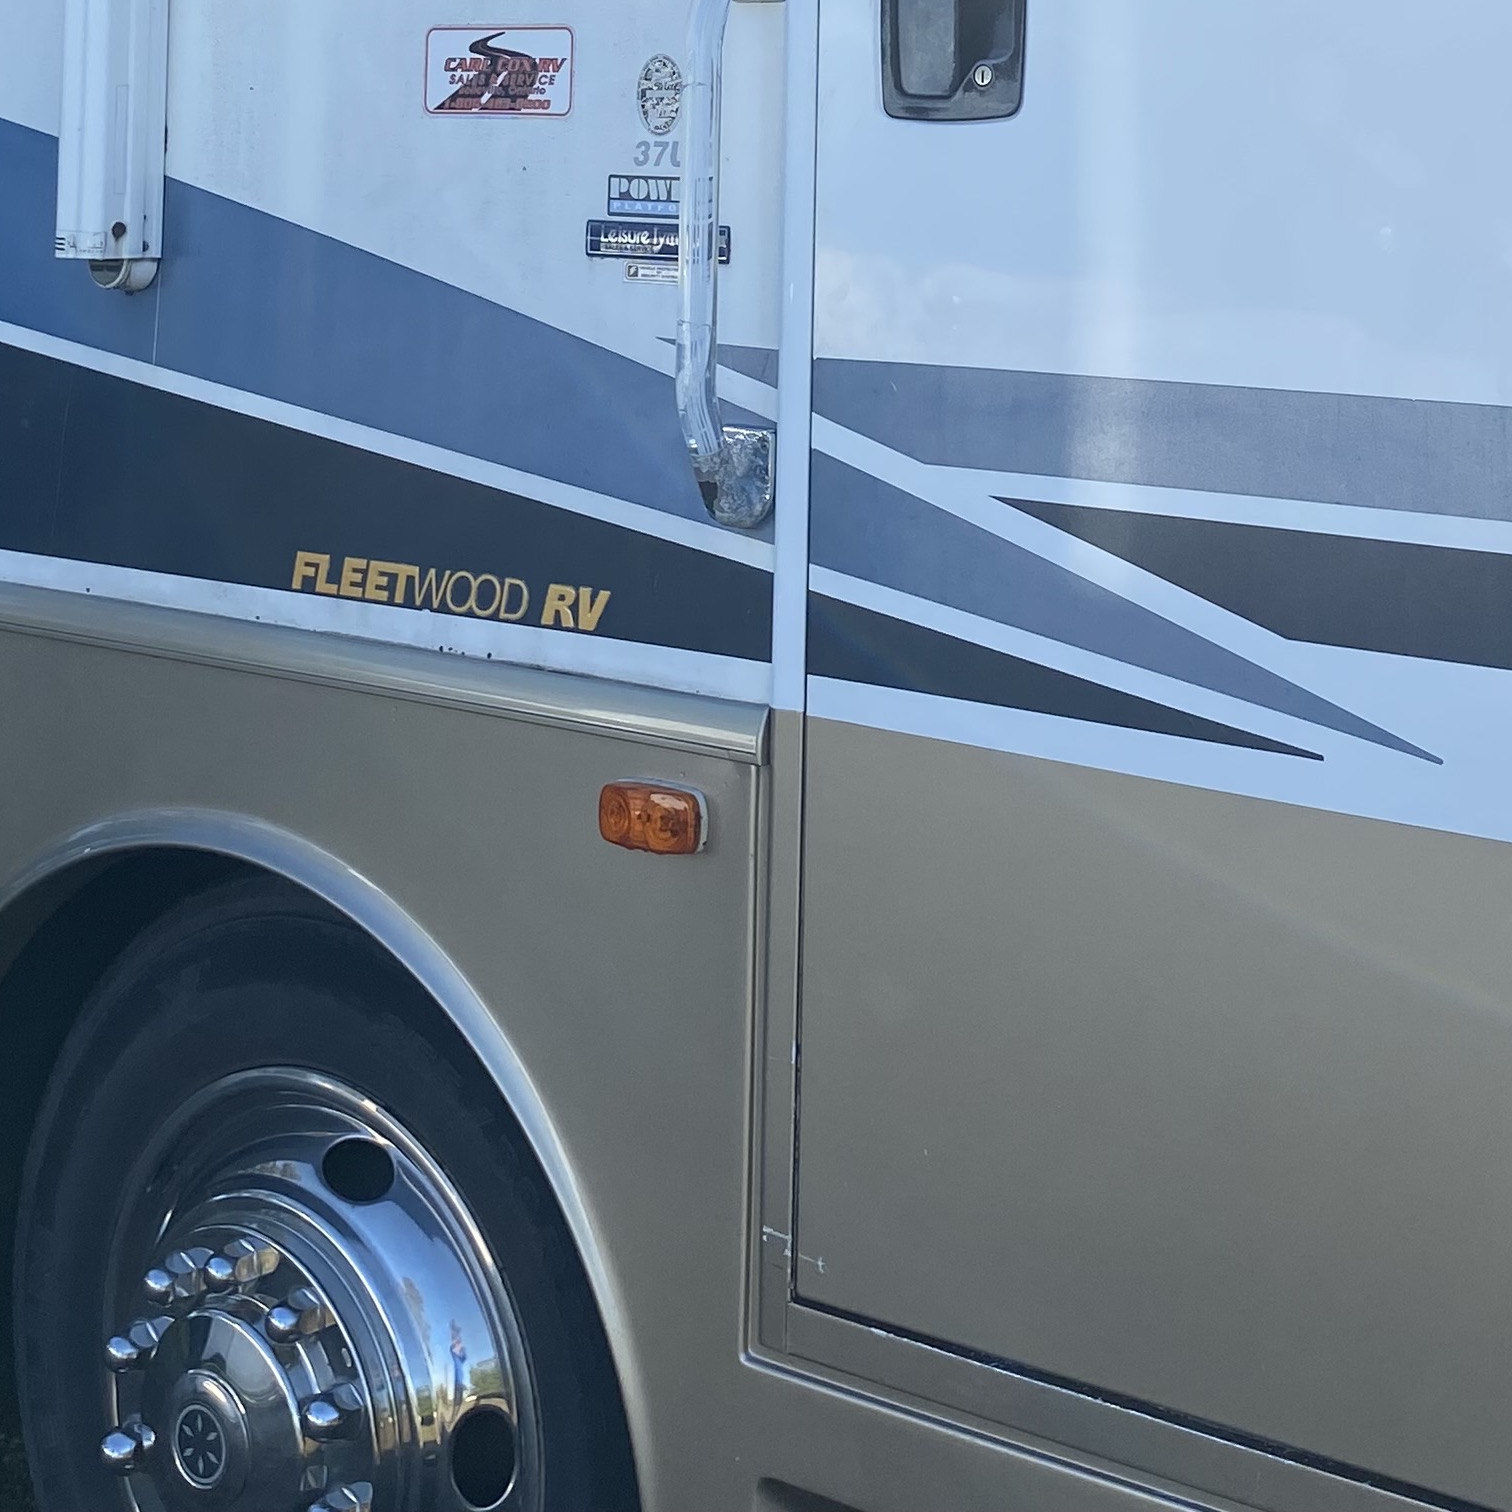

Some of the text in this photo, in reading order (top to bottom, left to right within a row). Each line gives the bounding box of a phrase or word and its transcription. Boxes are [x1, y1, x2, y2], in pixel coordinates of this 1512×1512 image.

[535, 57, 568, 73] RV
[600, 225, 679, 253] Leisure Tym
[291, 550, 611, 632] FLEETWOOD RV
